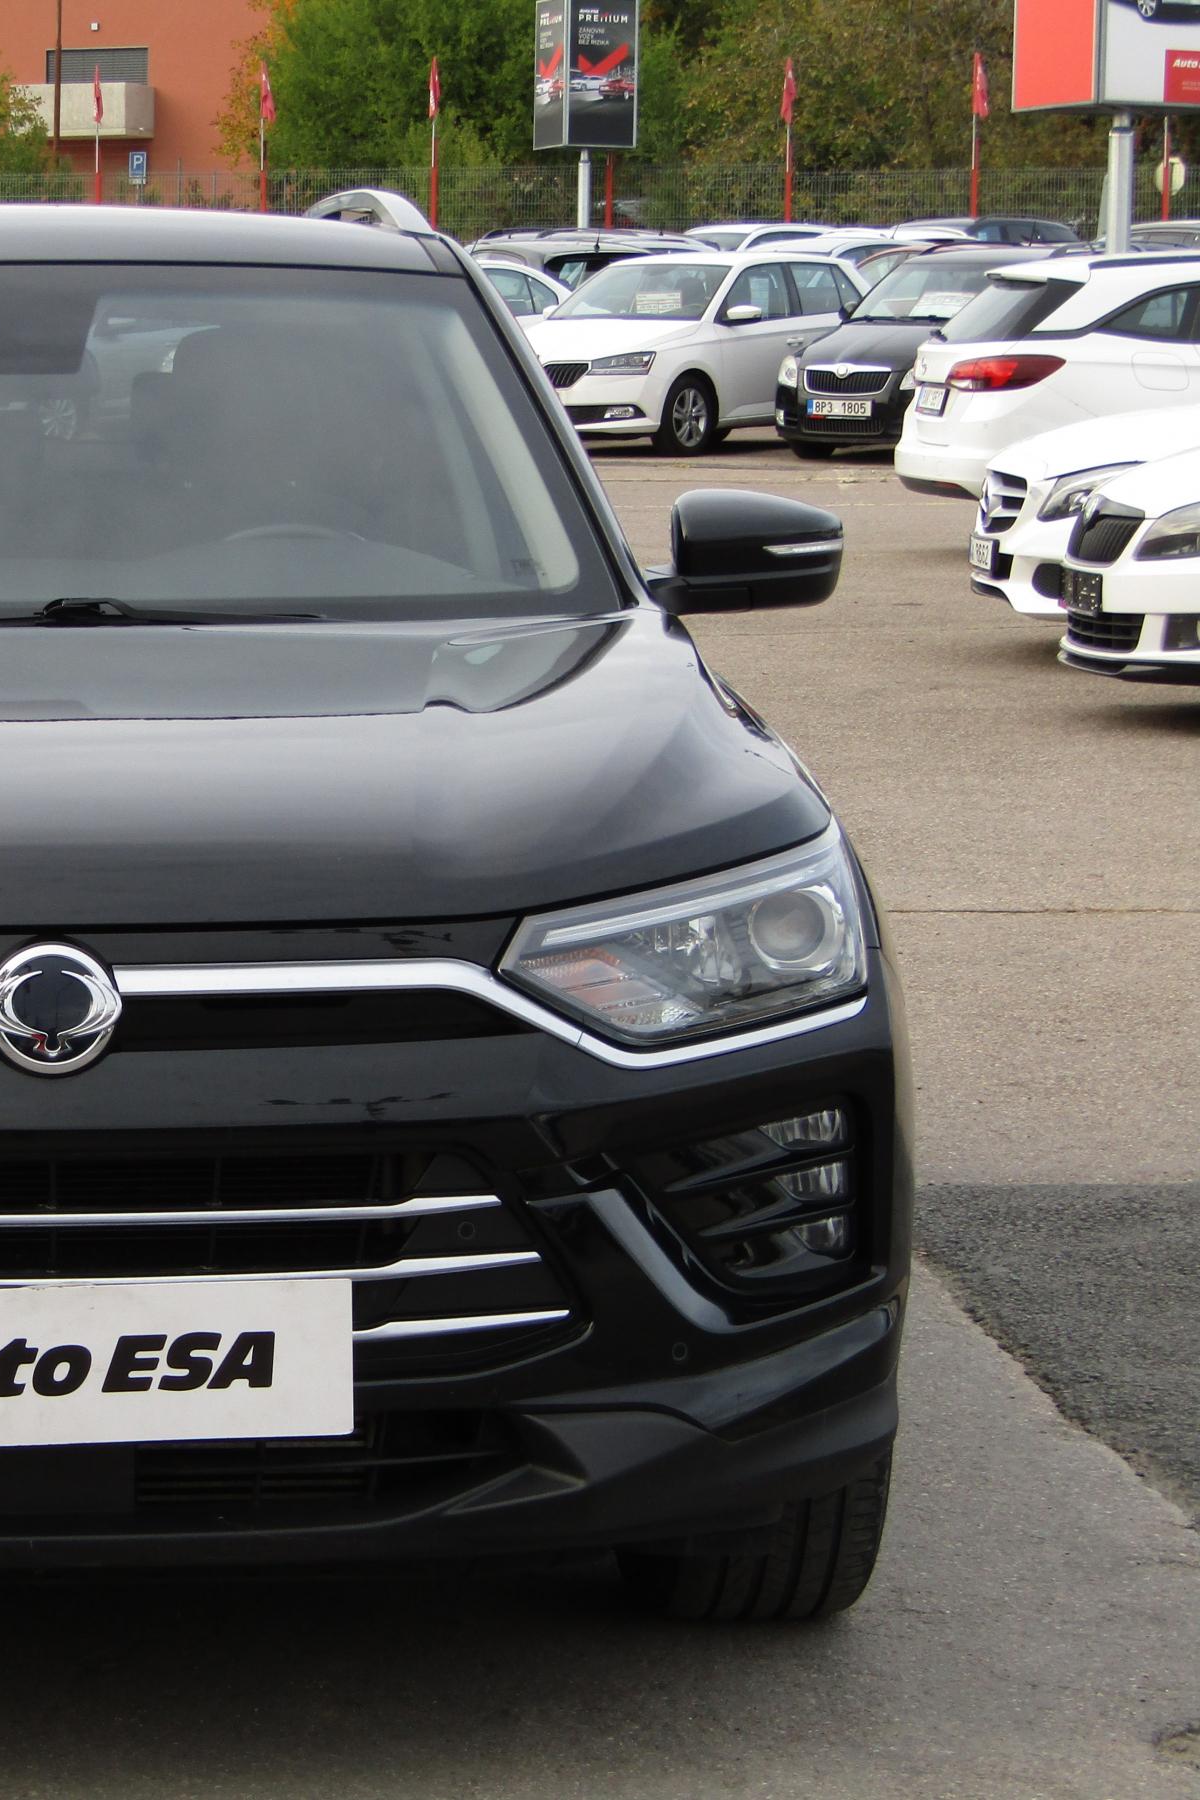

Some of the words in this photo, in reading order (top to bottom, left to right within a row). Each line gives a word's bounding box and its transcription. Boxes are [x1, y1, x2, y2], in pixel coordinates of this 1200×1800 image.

[578, 13, 628, 24] PREMIUM
[1172, 58, 1198, 69] Auto
[133, 154, 143, 169] P
[814, 401, 833, 414] 8P3
[841, 402, 866, 415] 1805
[101, 1331, 276, 1393] ESA
